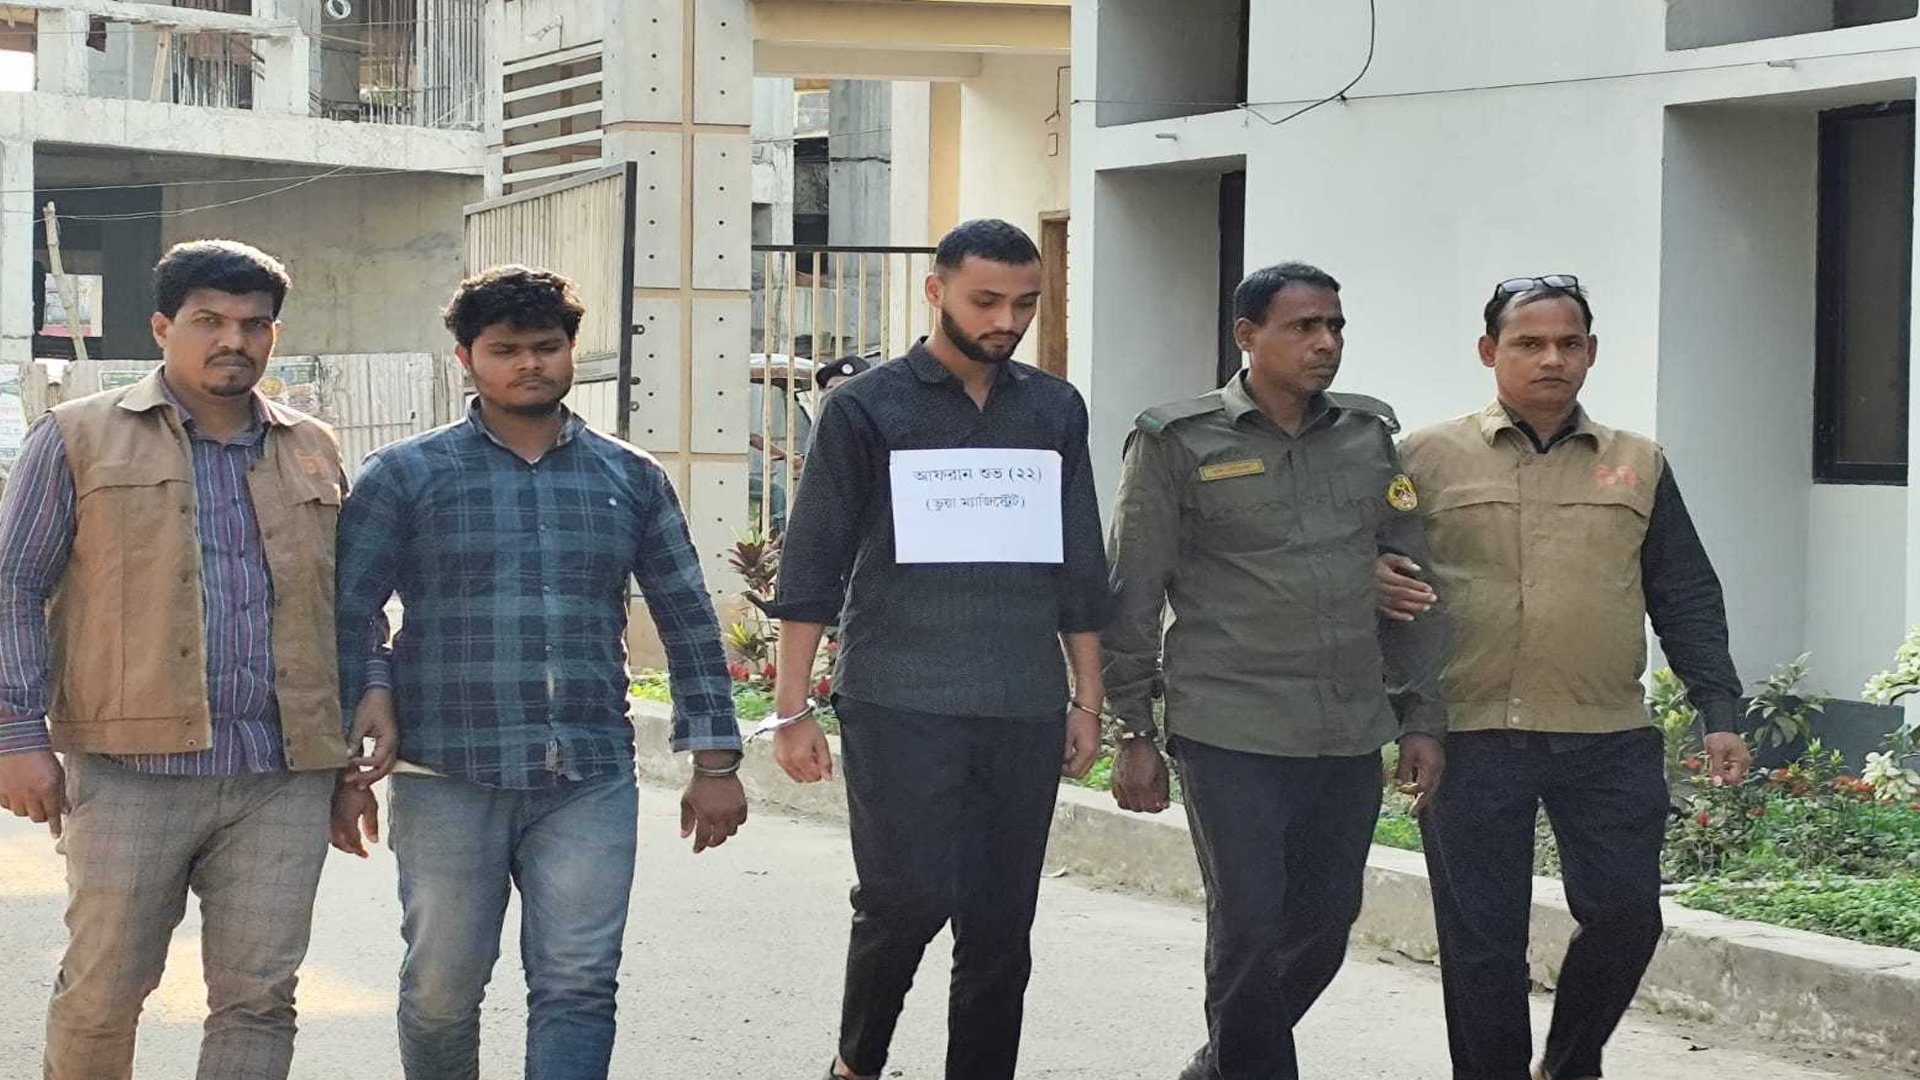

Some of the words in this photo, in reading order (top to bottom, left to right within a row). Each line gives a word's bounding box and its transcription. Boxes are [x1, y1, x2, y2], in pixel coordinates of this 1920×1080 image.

[912, 468, 973, 481] আফরান
[980, 467, 1004, 479] শুভ
[1008, 466, 1042, 483] (২২)
